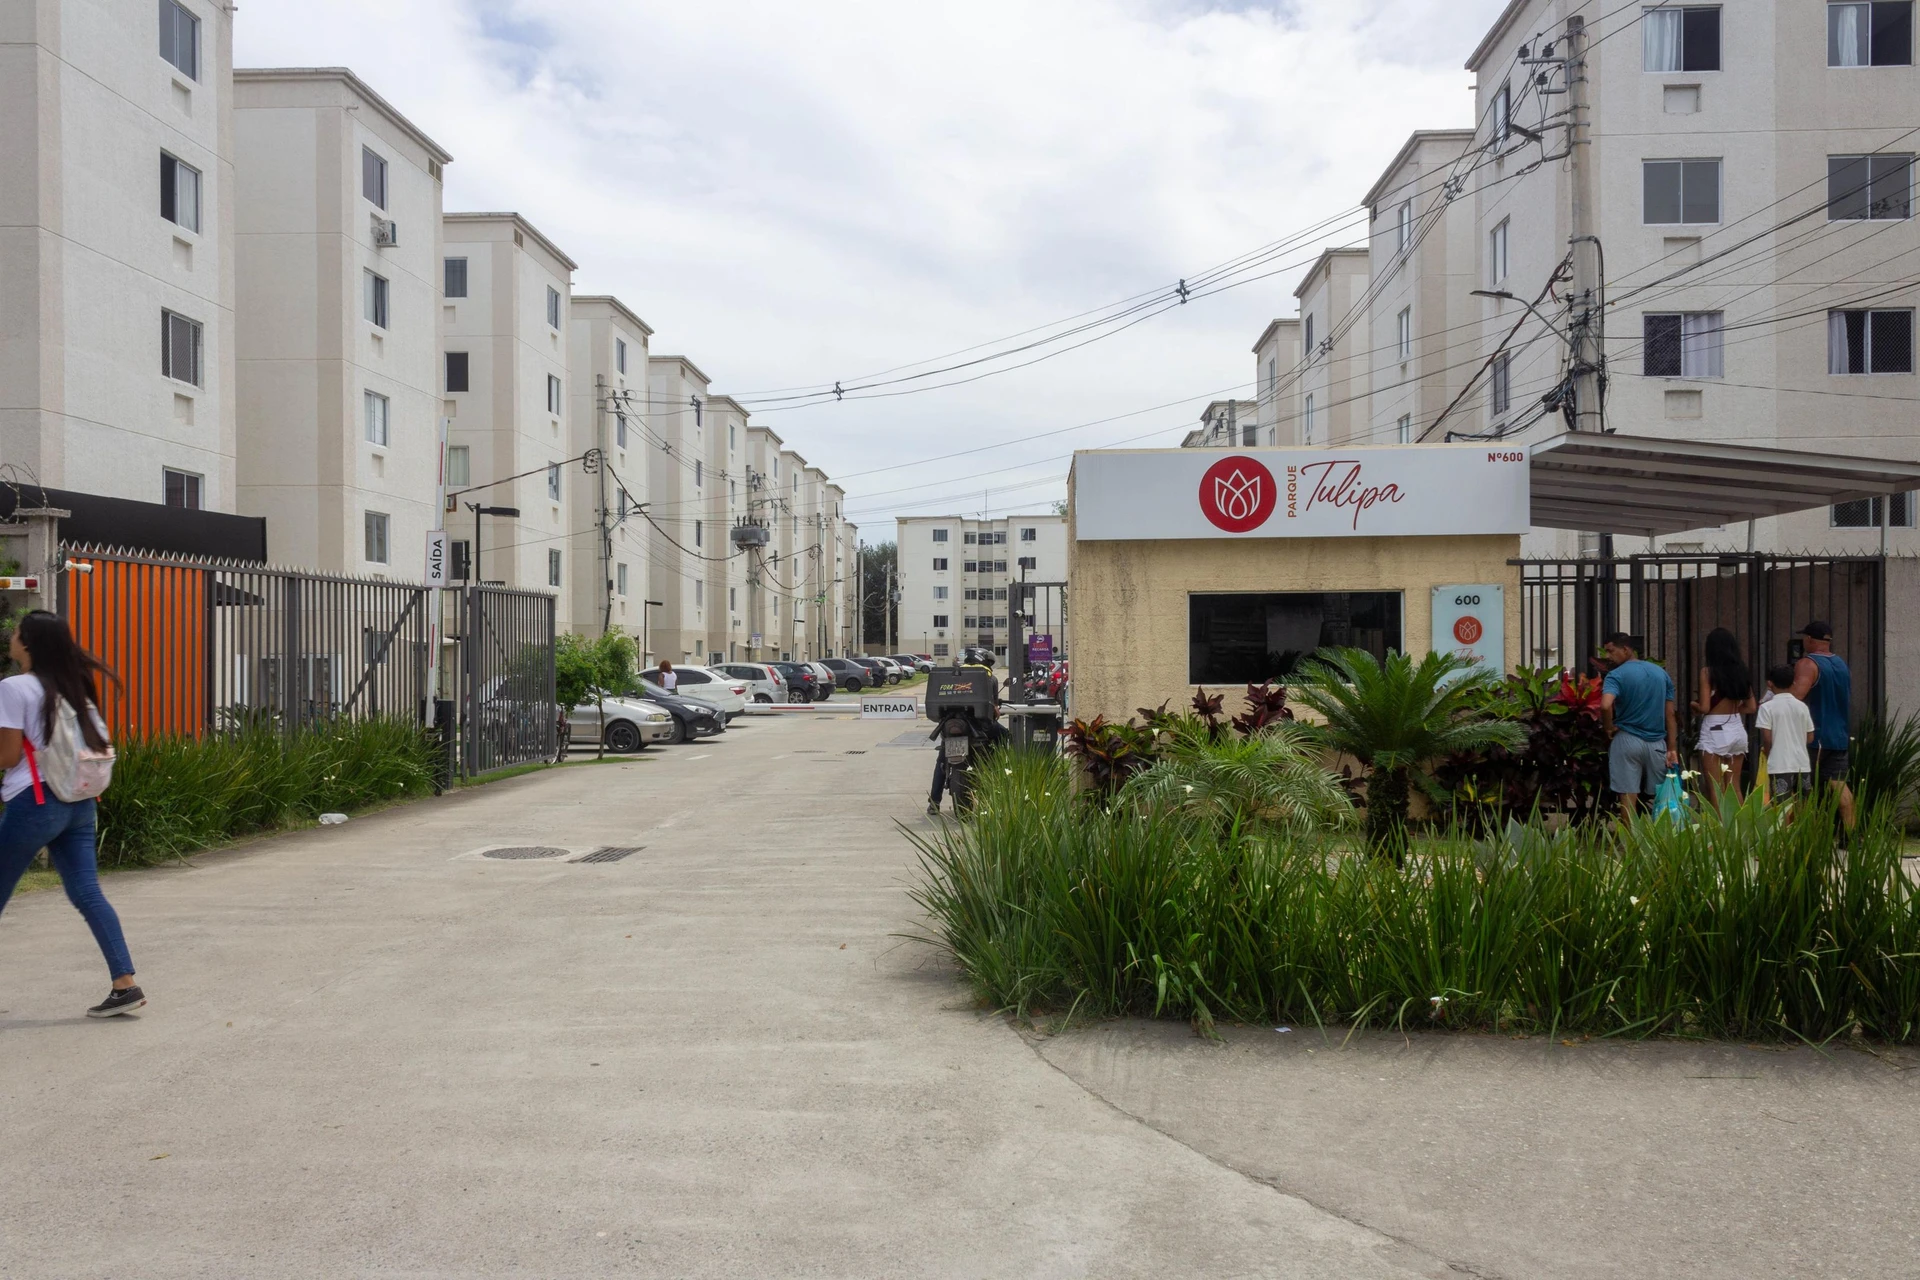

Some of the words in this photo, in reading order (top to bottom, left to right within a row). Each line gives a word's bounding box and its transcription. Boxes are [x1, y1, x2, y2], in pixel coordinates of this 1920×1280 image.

[1287, 465, 1297, 518] PARQUE
[1300, 460, 1406, 531] Tulipa
[429, 539, 443, 579] SAÍDA
[1454, 594, 1481, 606] 600
[863, 704, 915, 713] ENTRADA
